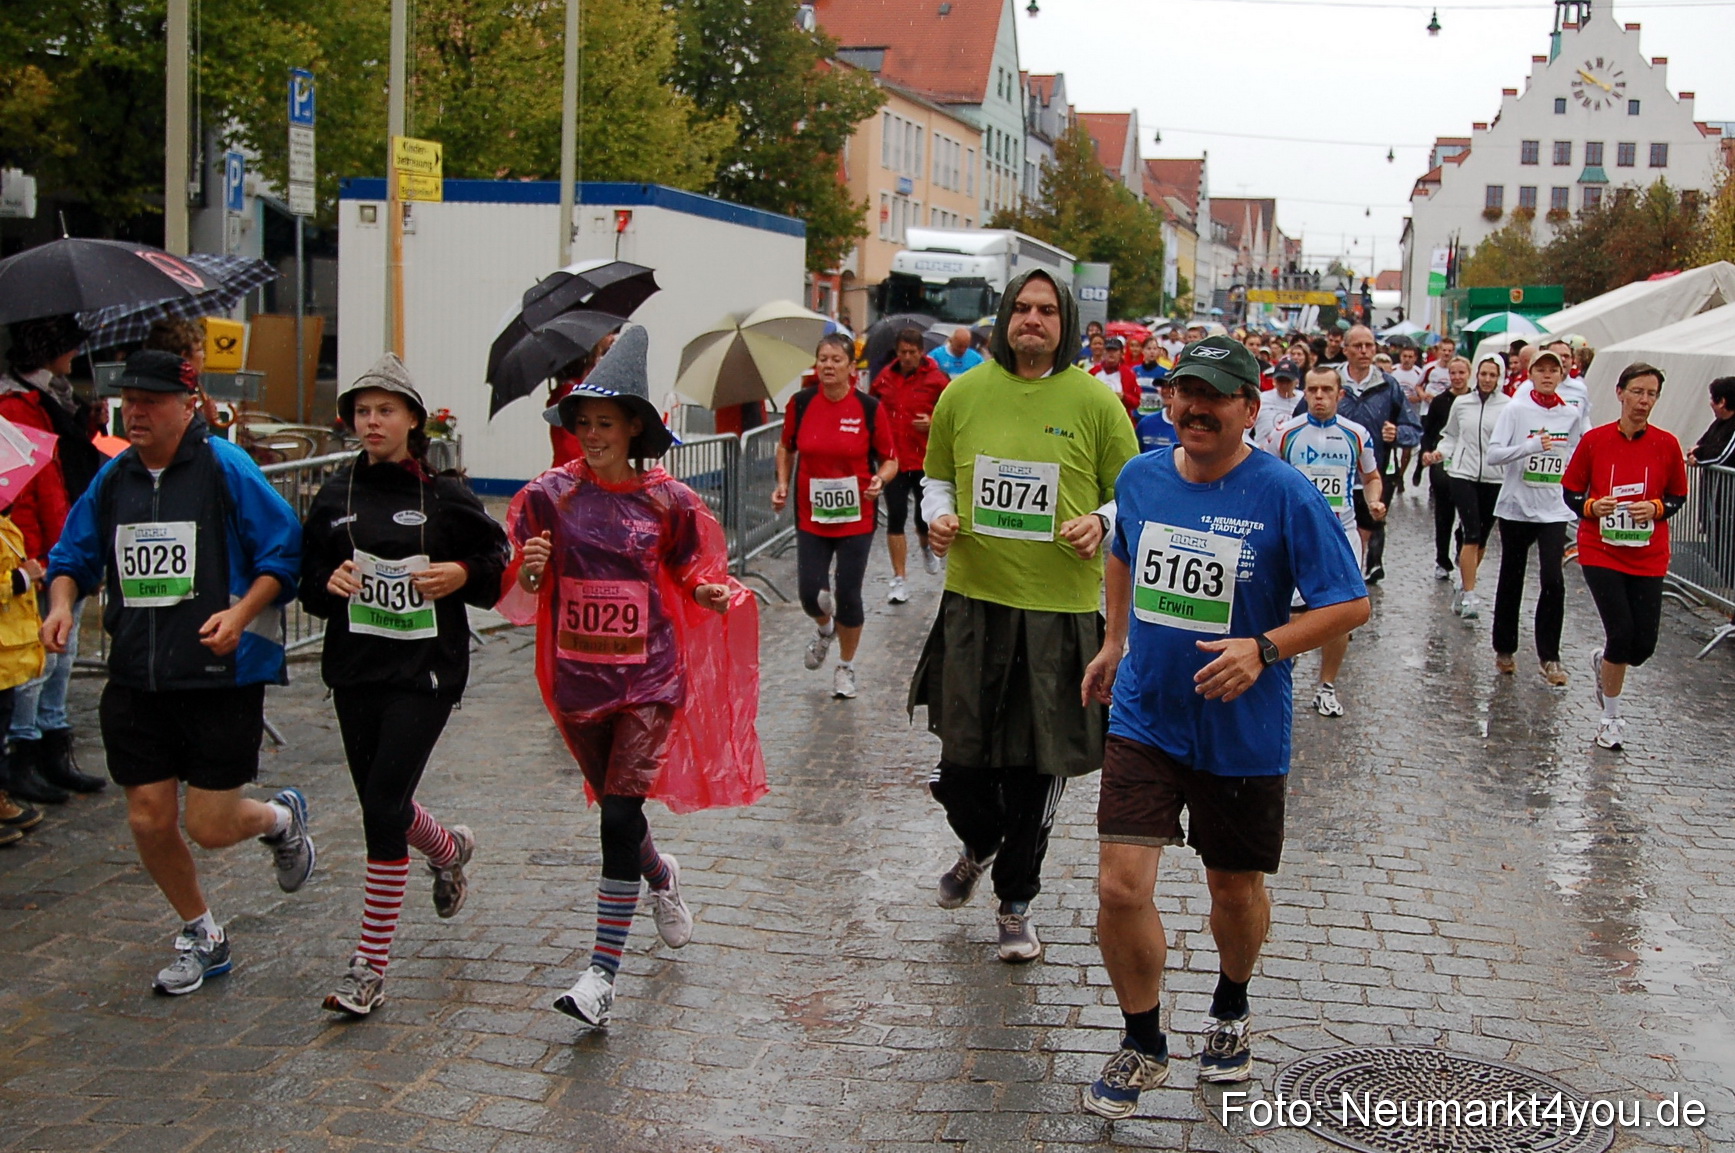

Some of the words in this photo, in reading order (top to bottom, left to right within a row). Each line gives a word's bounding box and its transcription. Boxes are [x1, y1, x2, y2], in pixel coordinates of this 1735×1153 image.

[294, 76, 310, 117] P
[230, 160, 242, 202] P
[1321, 452, 1348, 460] PLAST
[1529, 456, 1562, 473] 5179
[999, 465, 1032, 475] BOCK
[815, 490, 854, 508] 5060
[981, 478, 1048, 512] 5074
[997, 515, 1024, 528] Ivica
[1201, 515, 1213, 523] 12.
[1171, 534, 1208, 548] BOCK
[124, 544, 187, 576] 5028
[1144, 549, 1224, 598] 5163
[139, 582, 167, 595] Erwin
[360, 573, 424, 611] 5030
[1158, 596, 1194, 616] Erwin
[370, 611, 414, 628] Theresa
[567, 599, 639, 634] 5029
